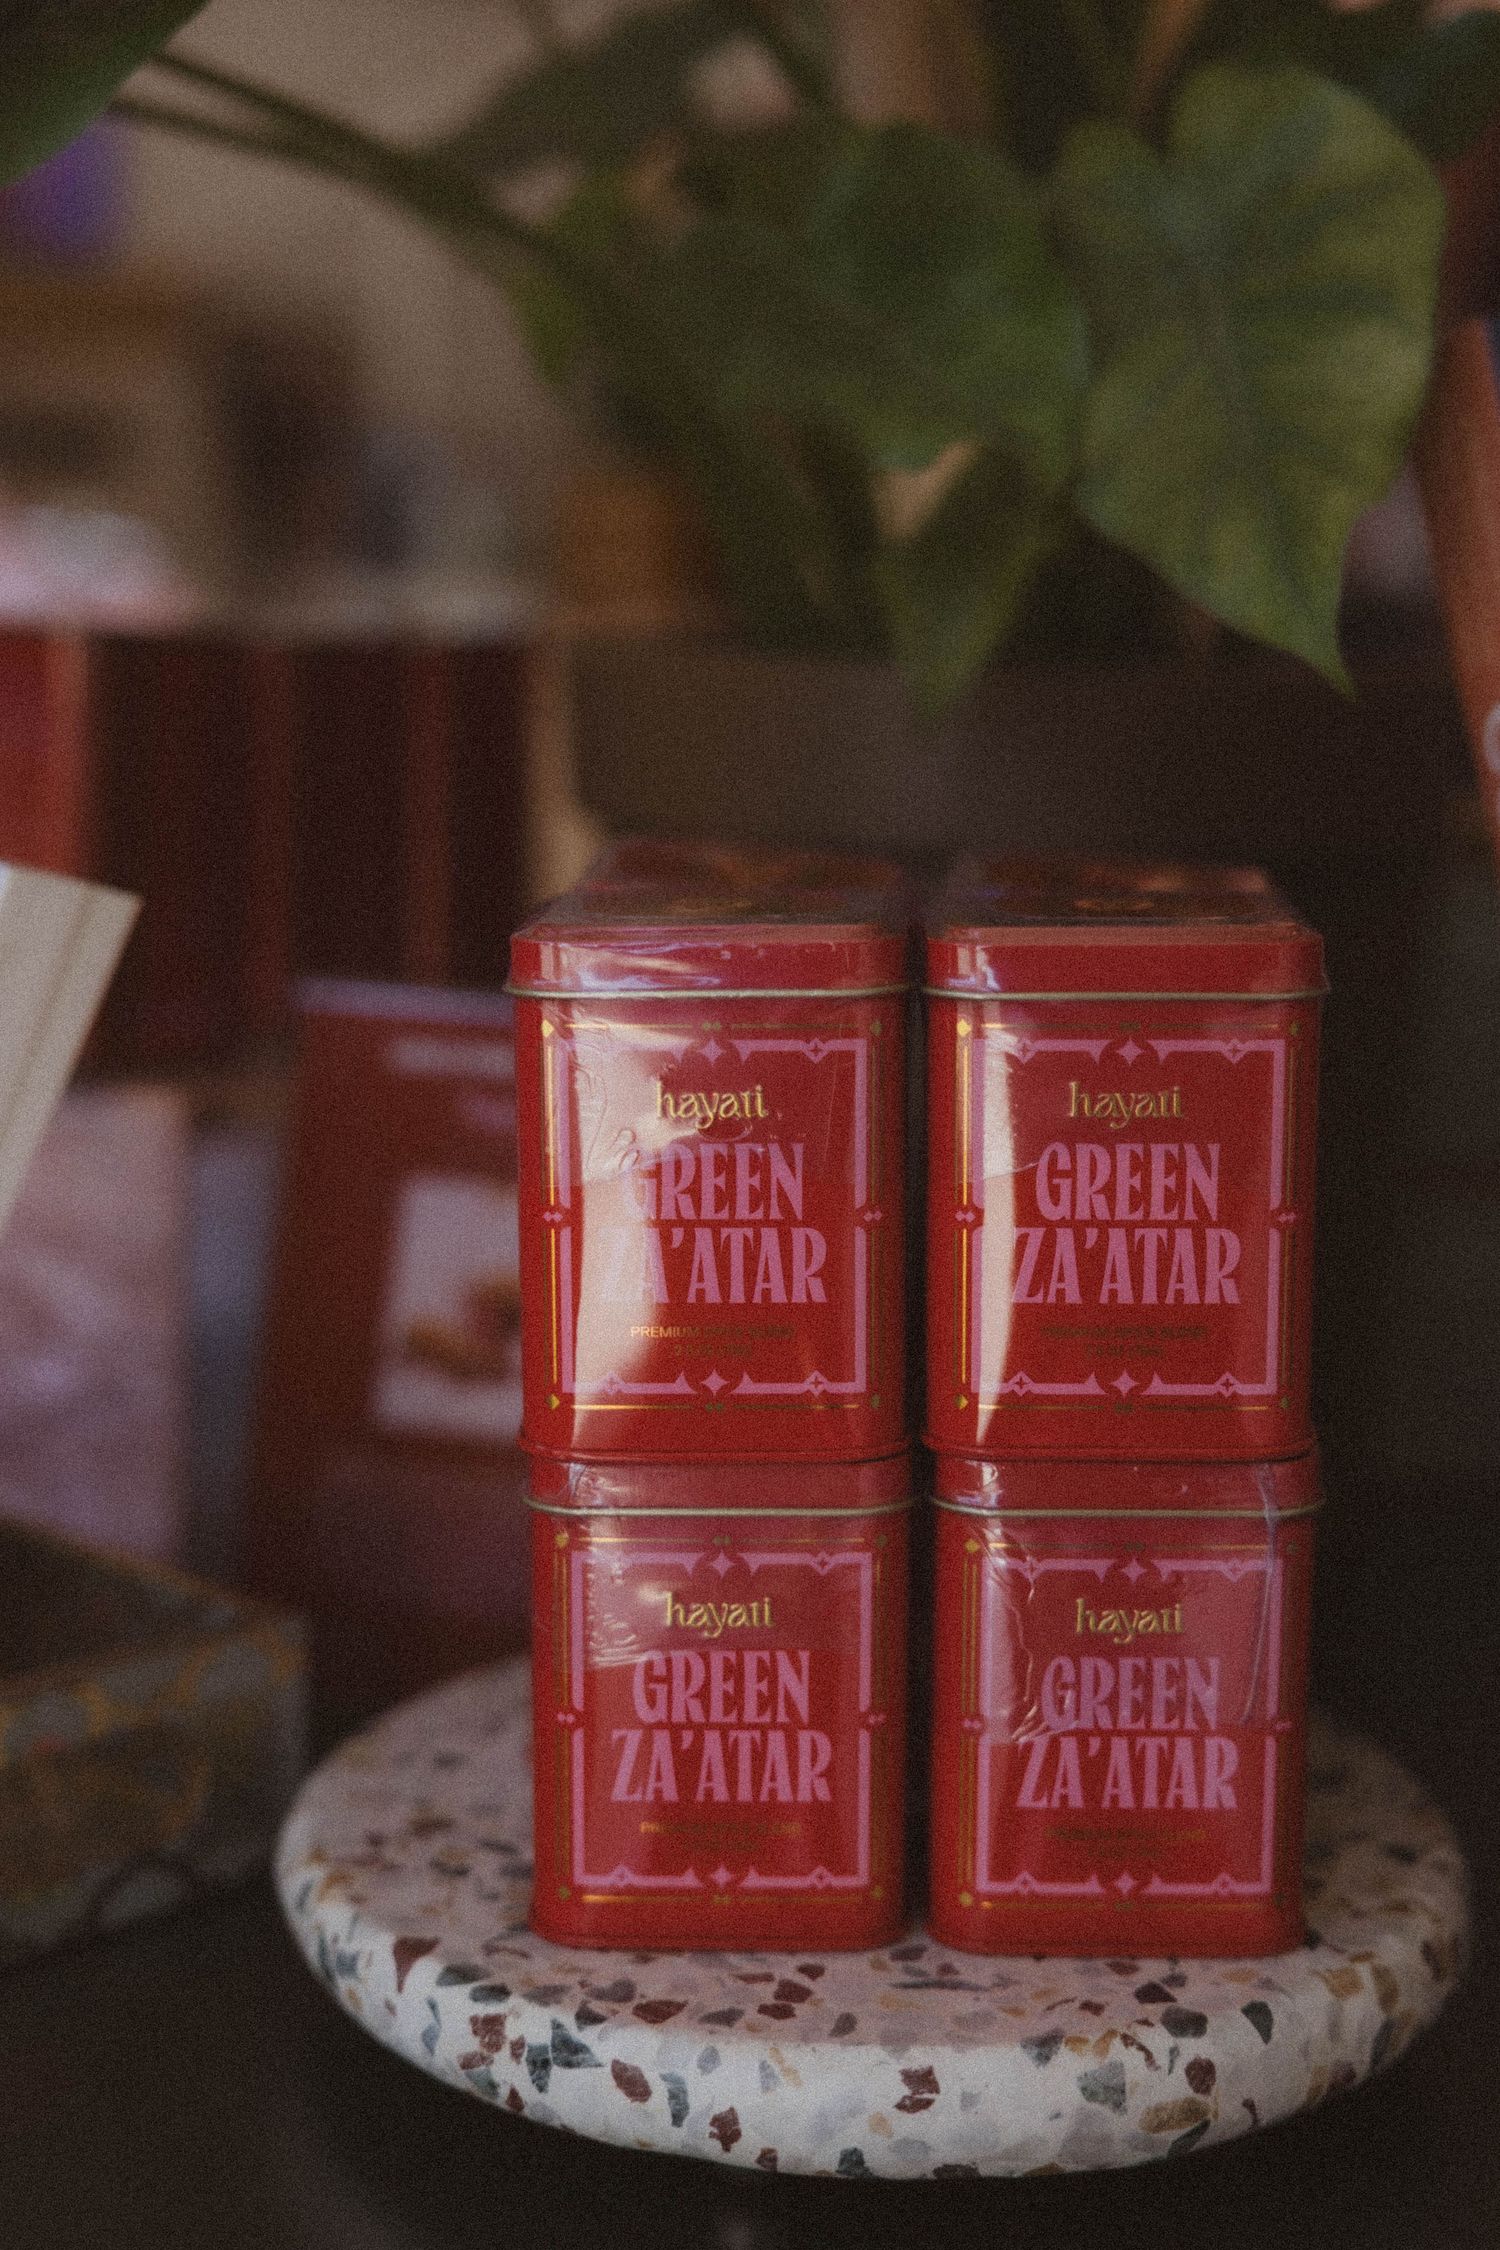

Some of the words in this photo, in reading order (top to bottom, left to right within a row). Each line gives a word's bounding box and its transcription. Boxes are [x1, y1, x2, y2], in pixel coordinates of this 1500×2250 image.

[655, 1080, 769, 1130] hayati
[1068, 1081, 1185, 1130] hayati
[621, 1141, 804, 1221] GREEN
[1035, 1141, 1221, 1222] GREEN
[1012, 1227, 1242, 1305] ZA'ATAR
[630, 1325, 700, 1338] PREMIUM
[662, 1591, 776, 1639] hayati
[1074, 1598, 1185, 1644] hayati
[632, 1649, 811, 1726] GREEN
[1041, 1655, 1222, 1733] GREEN
[609, 1729, 833, 1804] ZA'ATAR
[1014, 1736, 1240, 1810] ZA'ATAR
